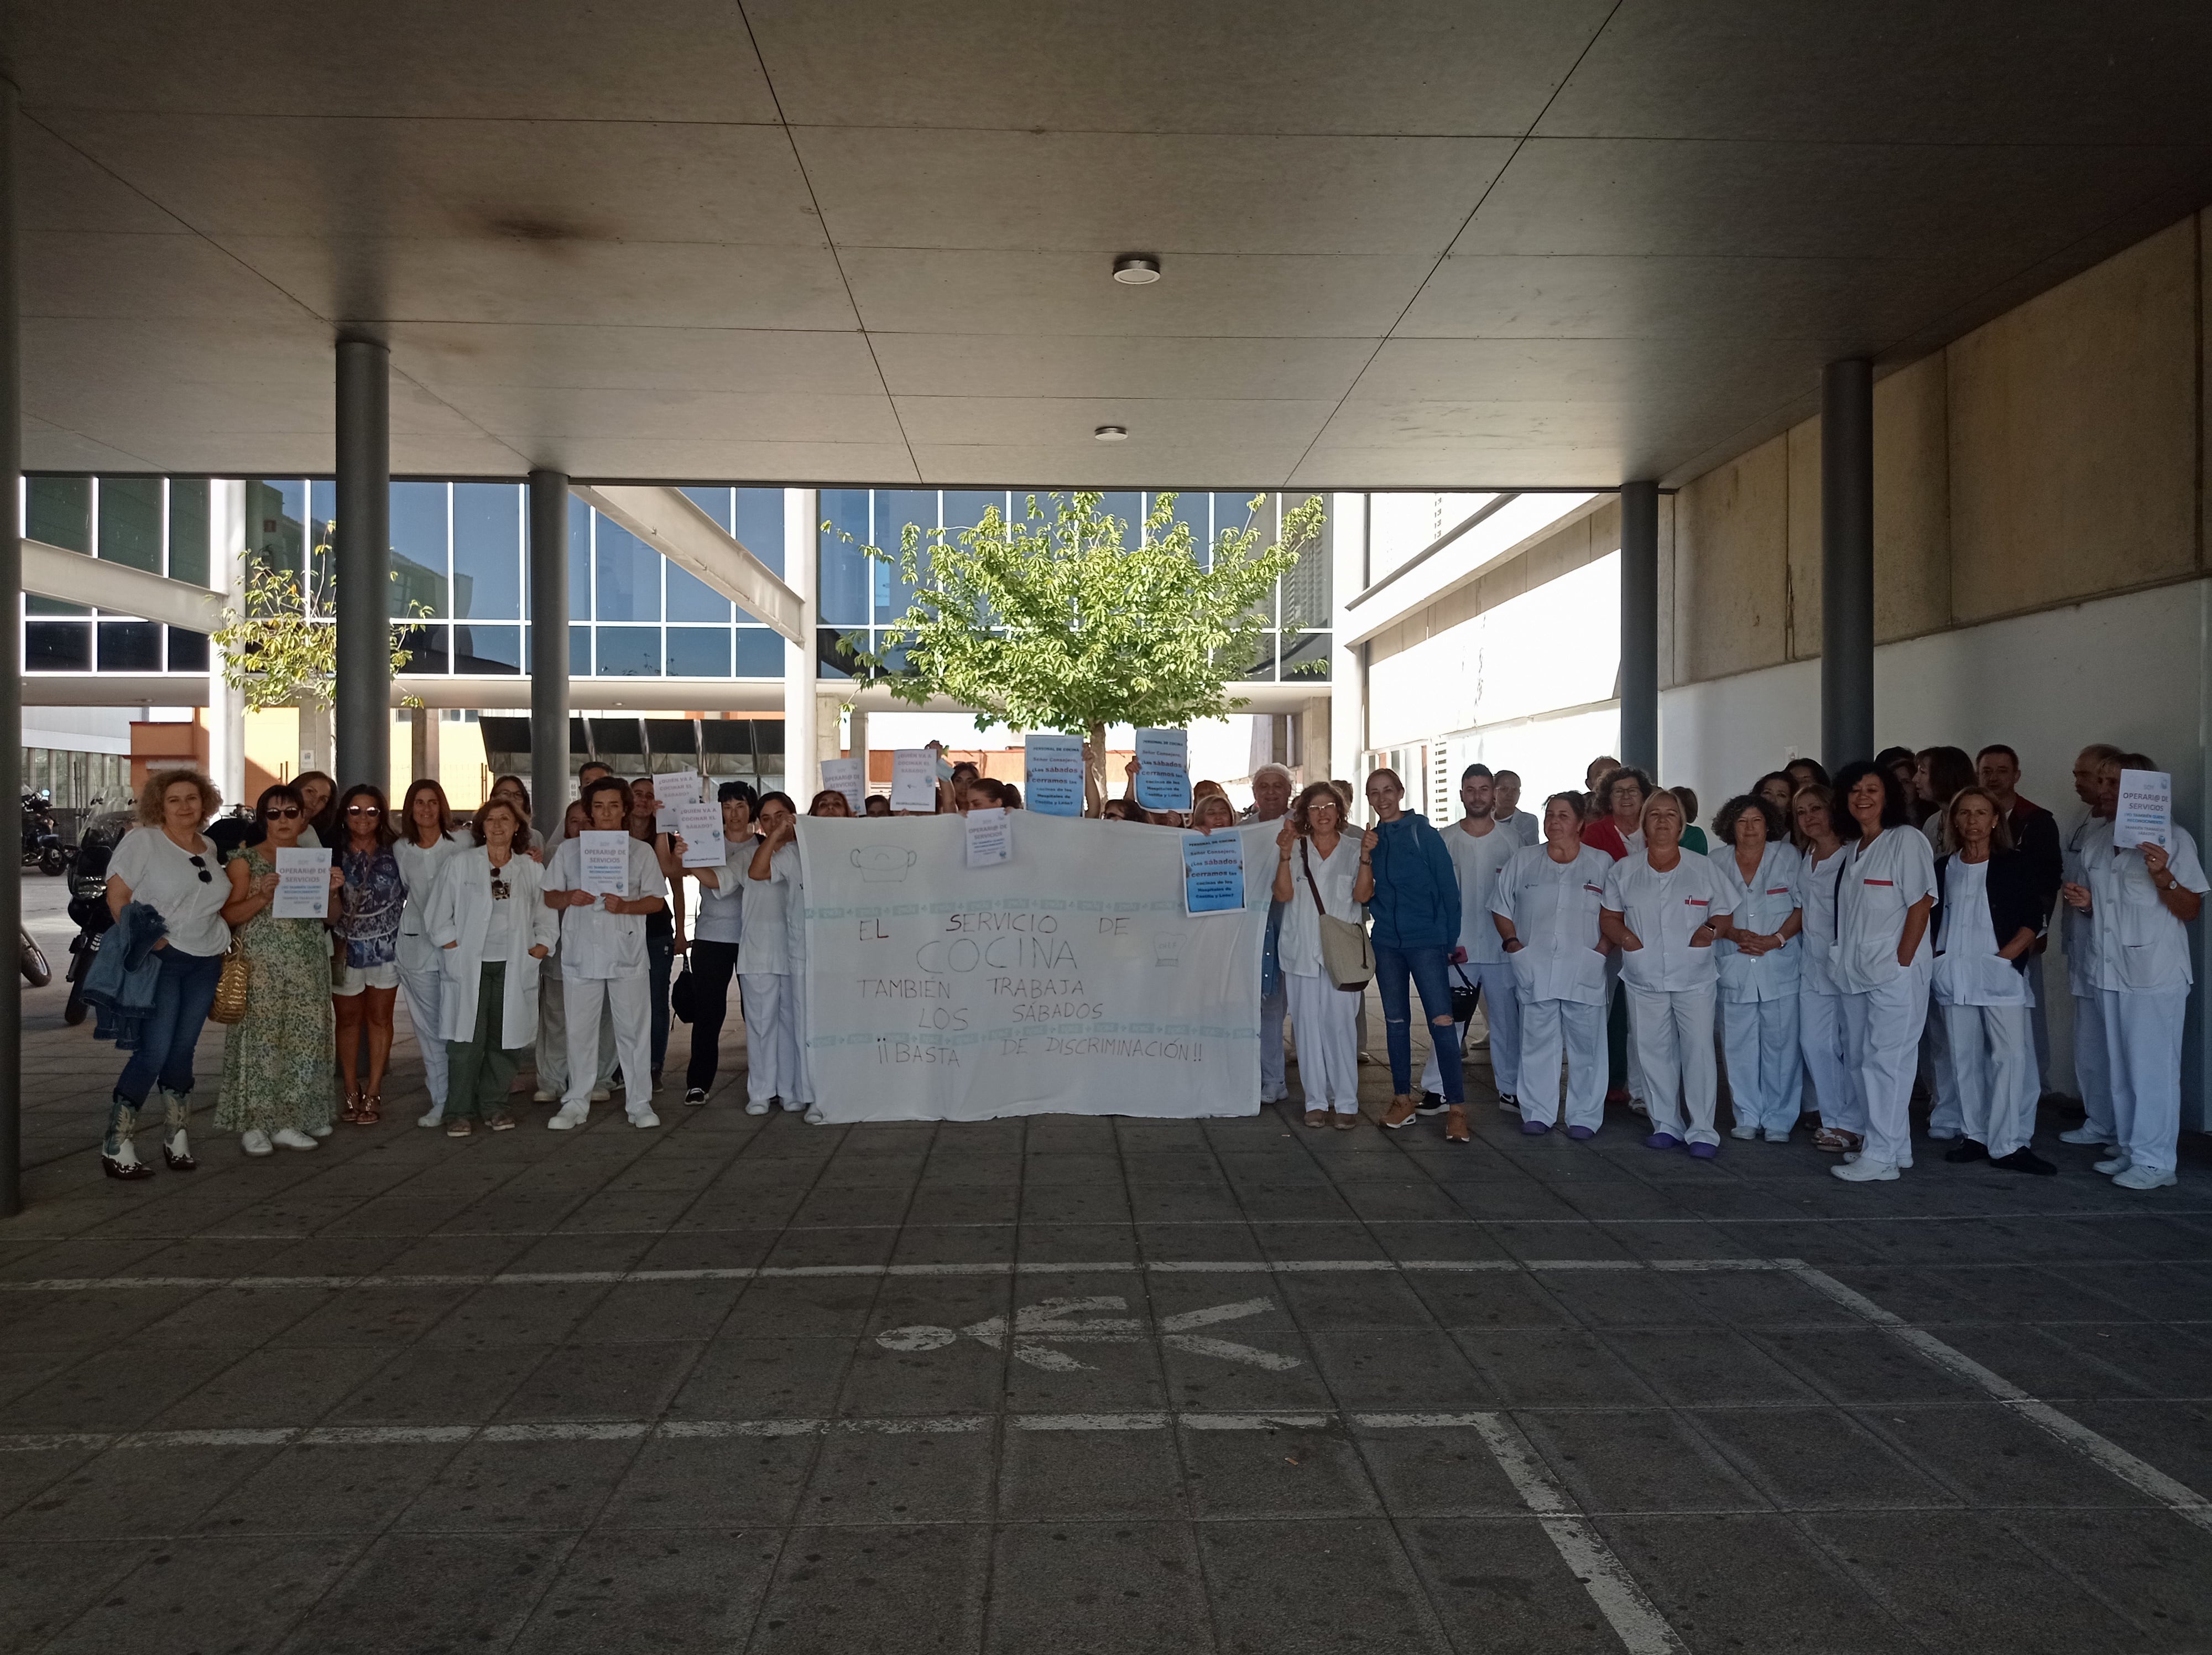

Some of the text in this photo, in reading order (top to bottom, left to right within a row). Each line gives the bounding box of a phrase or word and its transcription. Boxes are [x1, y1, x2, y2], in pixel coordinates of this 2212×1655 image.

[2124, 793, 2160, 802] OPERARI@
[2129, 803, 2164, 811] SERVICIOS
[859, 912, 1131, 941] EL SERVICIO DE
[916, 935, 1077, 974] COCINA
[857, 976, 1084, 999] TAMBIÉN TRABAJA
[919, 1001, 1103, 1031] LOS SÁBADOS
[999, 1038, 1030, 1057] DE
[1045, 1036, 1202, 1063] DISCRIMINACIÓN!!
